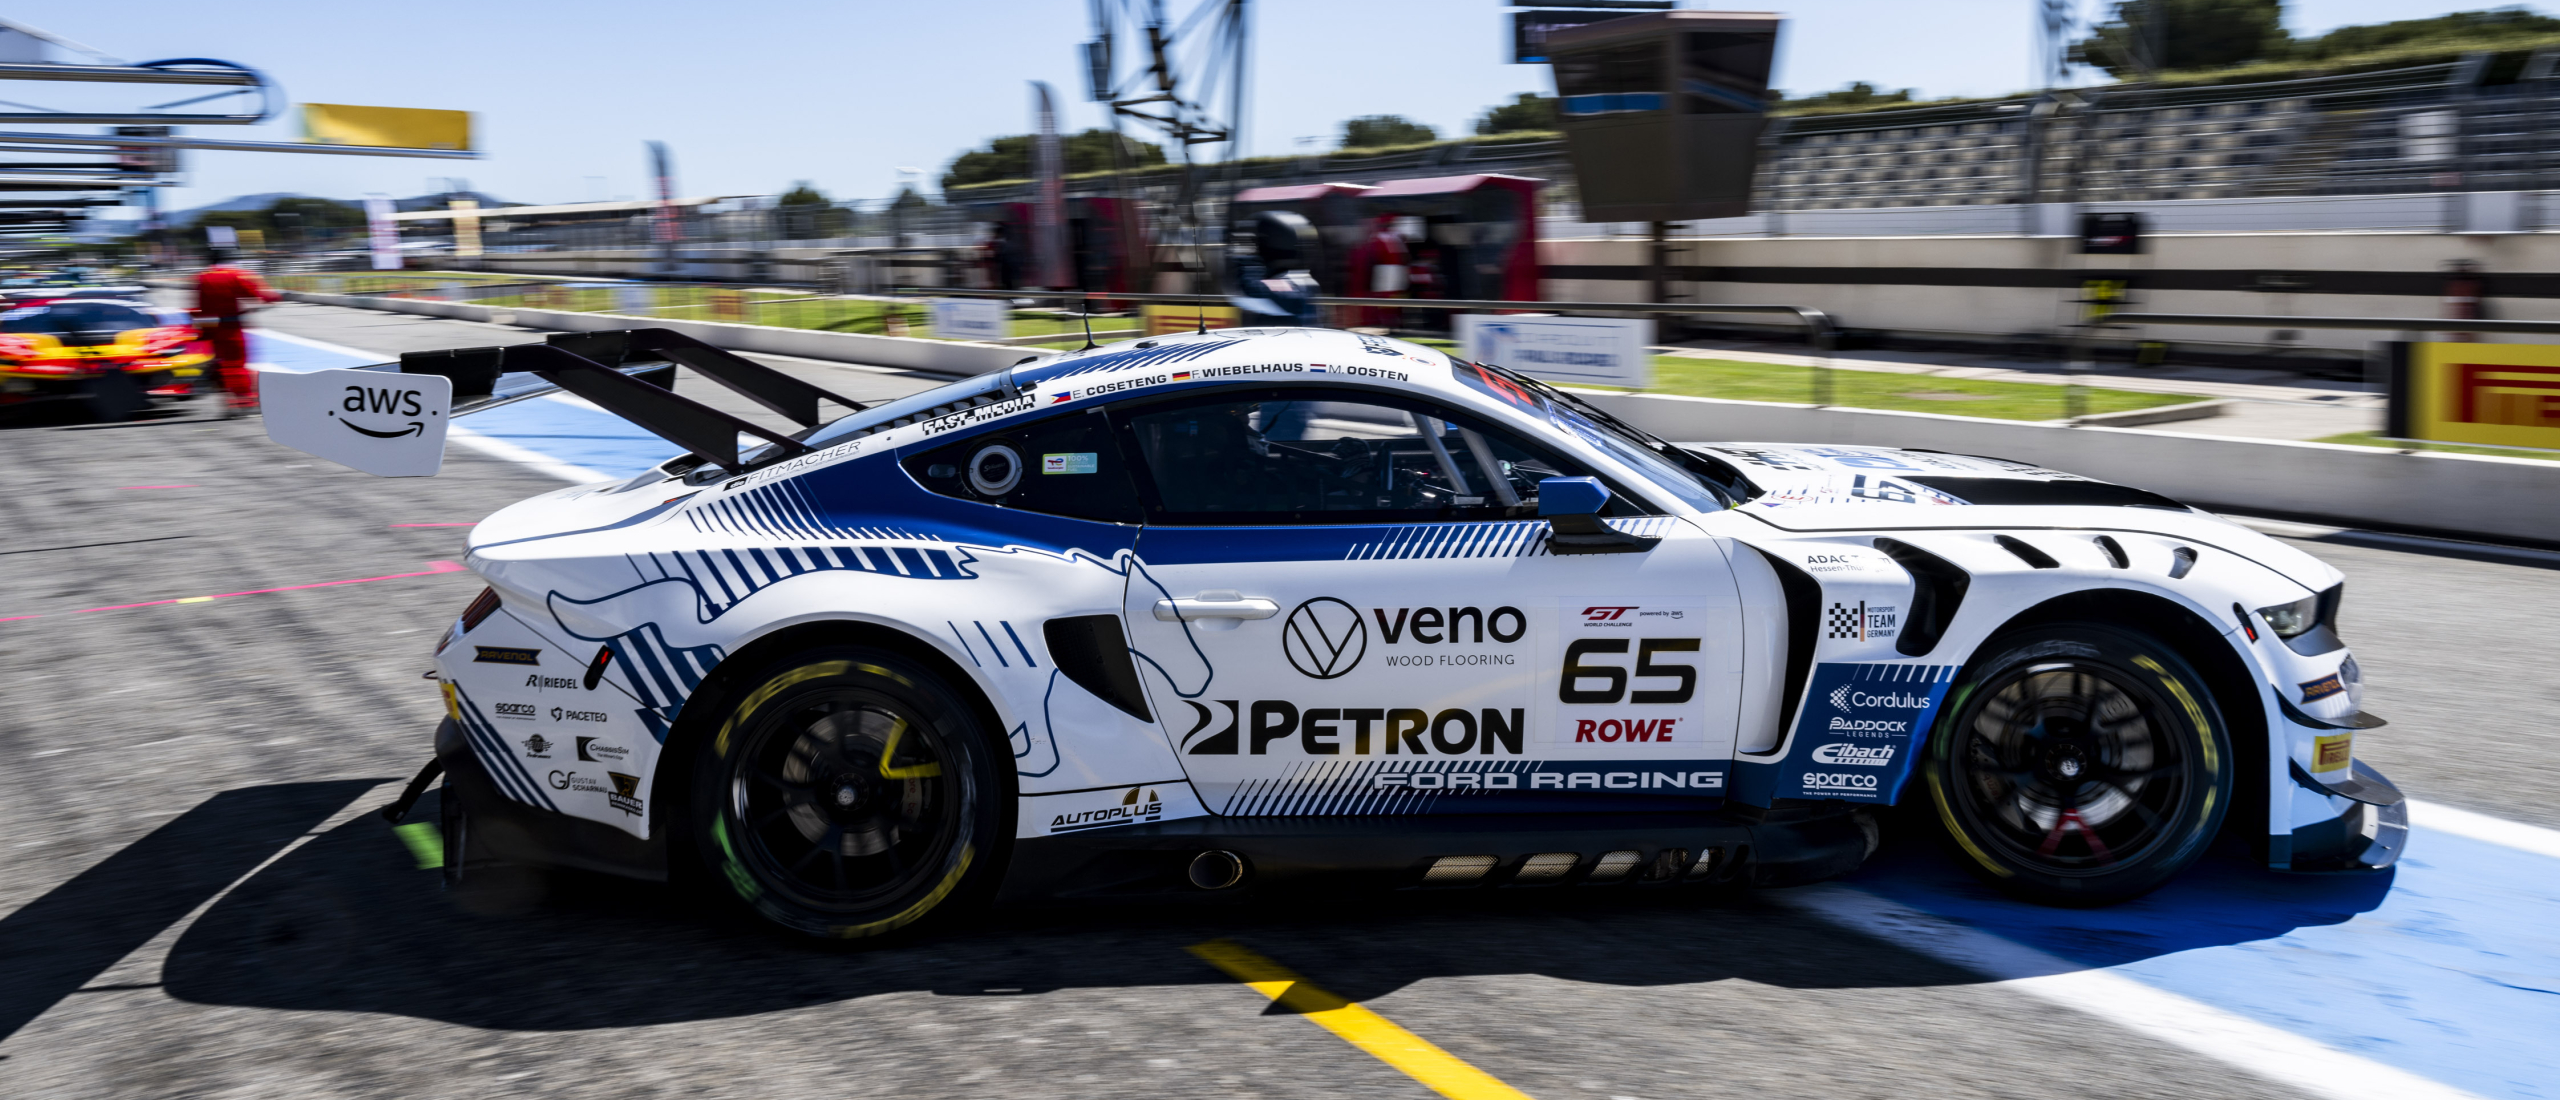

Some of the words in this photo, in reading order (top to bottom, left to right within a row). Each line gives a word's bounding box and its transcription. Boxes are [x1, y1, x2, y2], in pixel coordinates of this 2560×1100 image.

[1192, 370, 1200, 379] F.
[1202, 363, 1303, 378] WIEBELHAUS
[1329, 365, 1345, 374] M.
[1347, 366, 1408, 382] OOSTEN
[1072, 390, 1085, 399] E.
[1086, 375, 1167, 396] COSETENG
[343, 386, 422, 417] aws
[748, 441, 861, 484] FITMACHER
[1808, 555, 1849, 564] ADAC
[1373, 605, 1527, 644] veno
[1867, 614, 1896, 628] TEAM
[1867, 629, 1895, 638] GERMANY
[480, 650, 534, 662] RAVENOL
[1386, 655, 1434, 667] WOOD
[1439, 654, 1515, 666] FLOORING
[1559, 637, 1701, 705] 65
[544, 677, 579, 690] RIEDEL
[1852, 691, 1931, 709] Cordulus
[495, 703, 536, 715] sparco
[566, 710, 608, 723] PACETEQ
[1250, 700, 1525, 755] PETRON
[1575, 718, 1677, 743] ROWE
[1829, 716, 1908, 732] PADDOCK
[1846, 731, 1889, 739] LEGENDS
[1812, 743, 1895, 766] Eibach
[571, 777, 597, 785] GUSTAV
[1373, 771, 1518, 790] FORD
[1530, 771, 1723, 789] RACING
[1803, 772, 1878, 789] sparco
[572, 784, 608, 794] SCHARNAU
[610, 793, 643, 809] BAUER
[1051, 803, 1162, 826] AUTOPLUS
